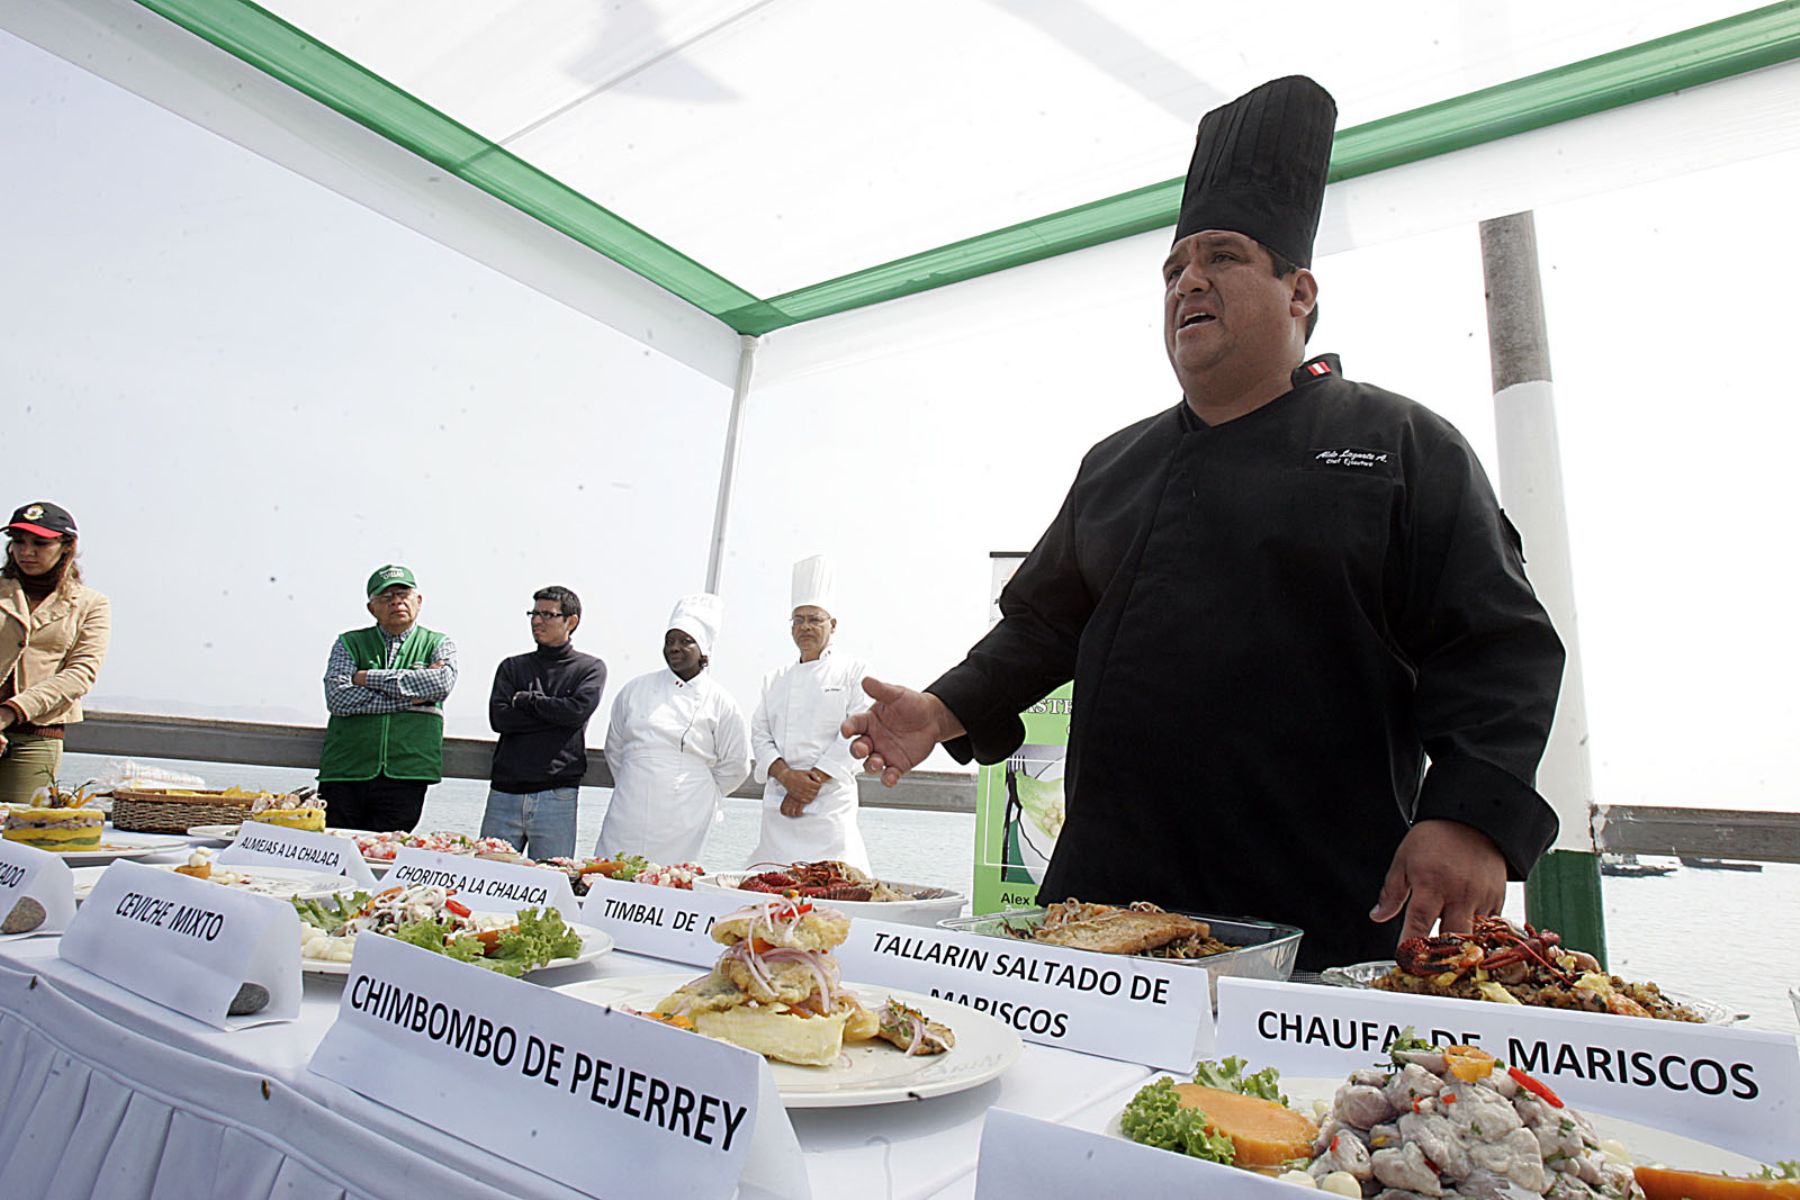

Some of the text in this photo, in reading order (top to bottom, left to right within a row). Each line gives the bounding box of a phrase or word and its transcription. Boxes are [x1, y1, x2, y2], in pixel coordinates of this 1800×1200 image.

[241, 836, 340, 867] ALMEJAS A LA CHALACA
[395, 865, 548, 905] CHORITOS A LA CHALACA
[1000, 892, 1030, 906] Alex
[115, 892, 224, 942] CEVICHE MIXTO
[604, 899, 664, 927] TIMBAL
[672, 911, 699, 932] DE
[873, 933, 1170, 1005] TALLARIN SALTADO DE
[351, 975, 748, 1152] CHIMBOMBO DE PEJERREY
[1508, 1038, 1759, 1100] MARISCOS
